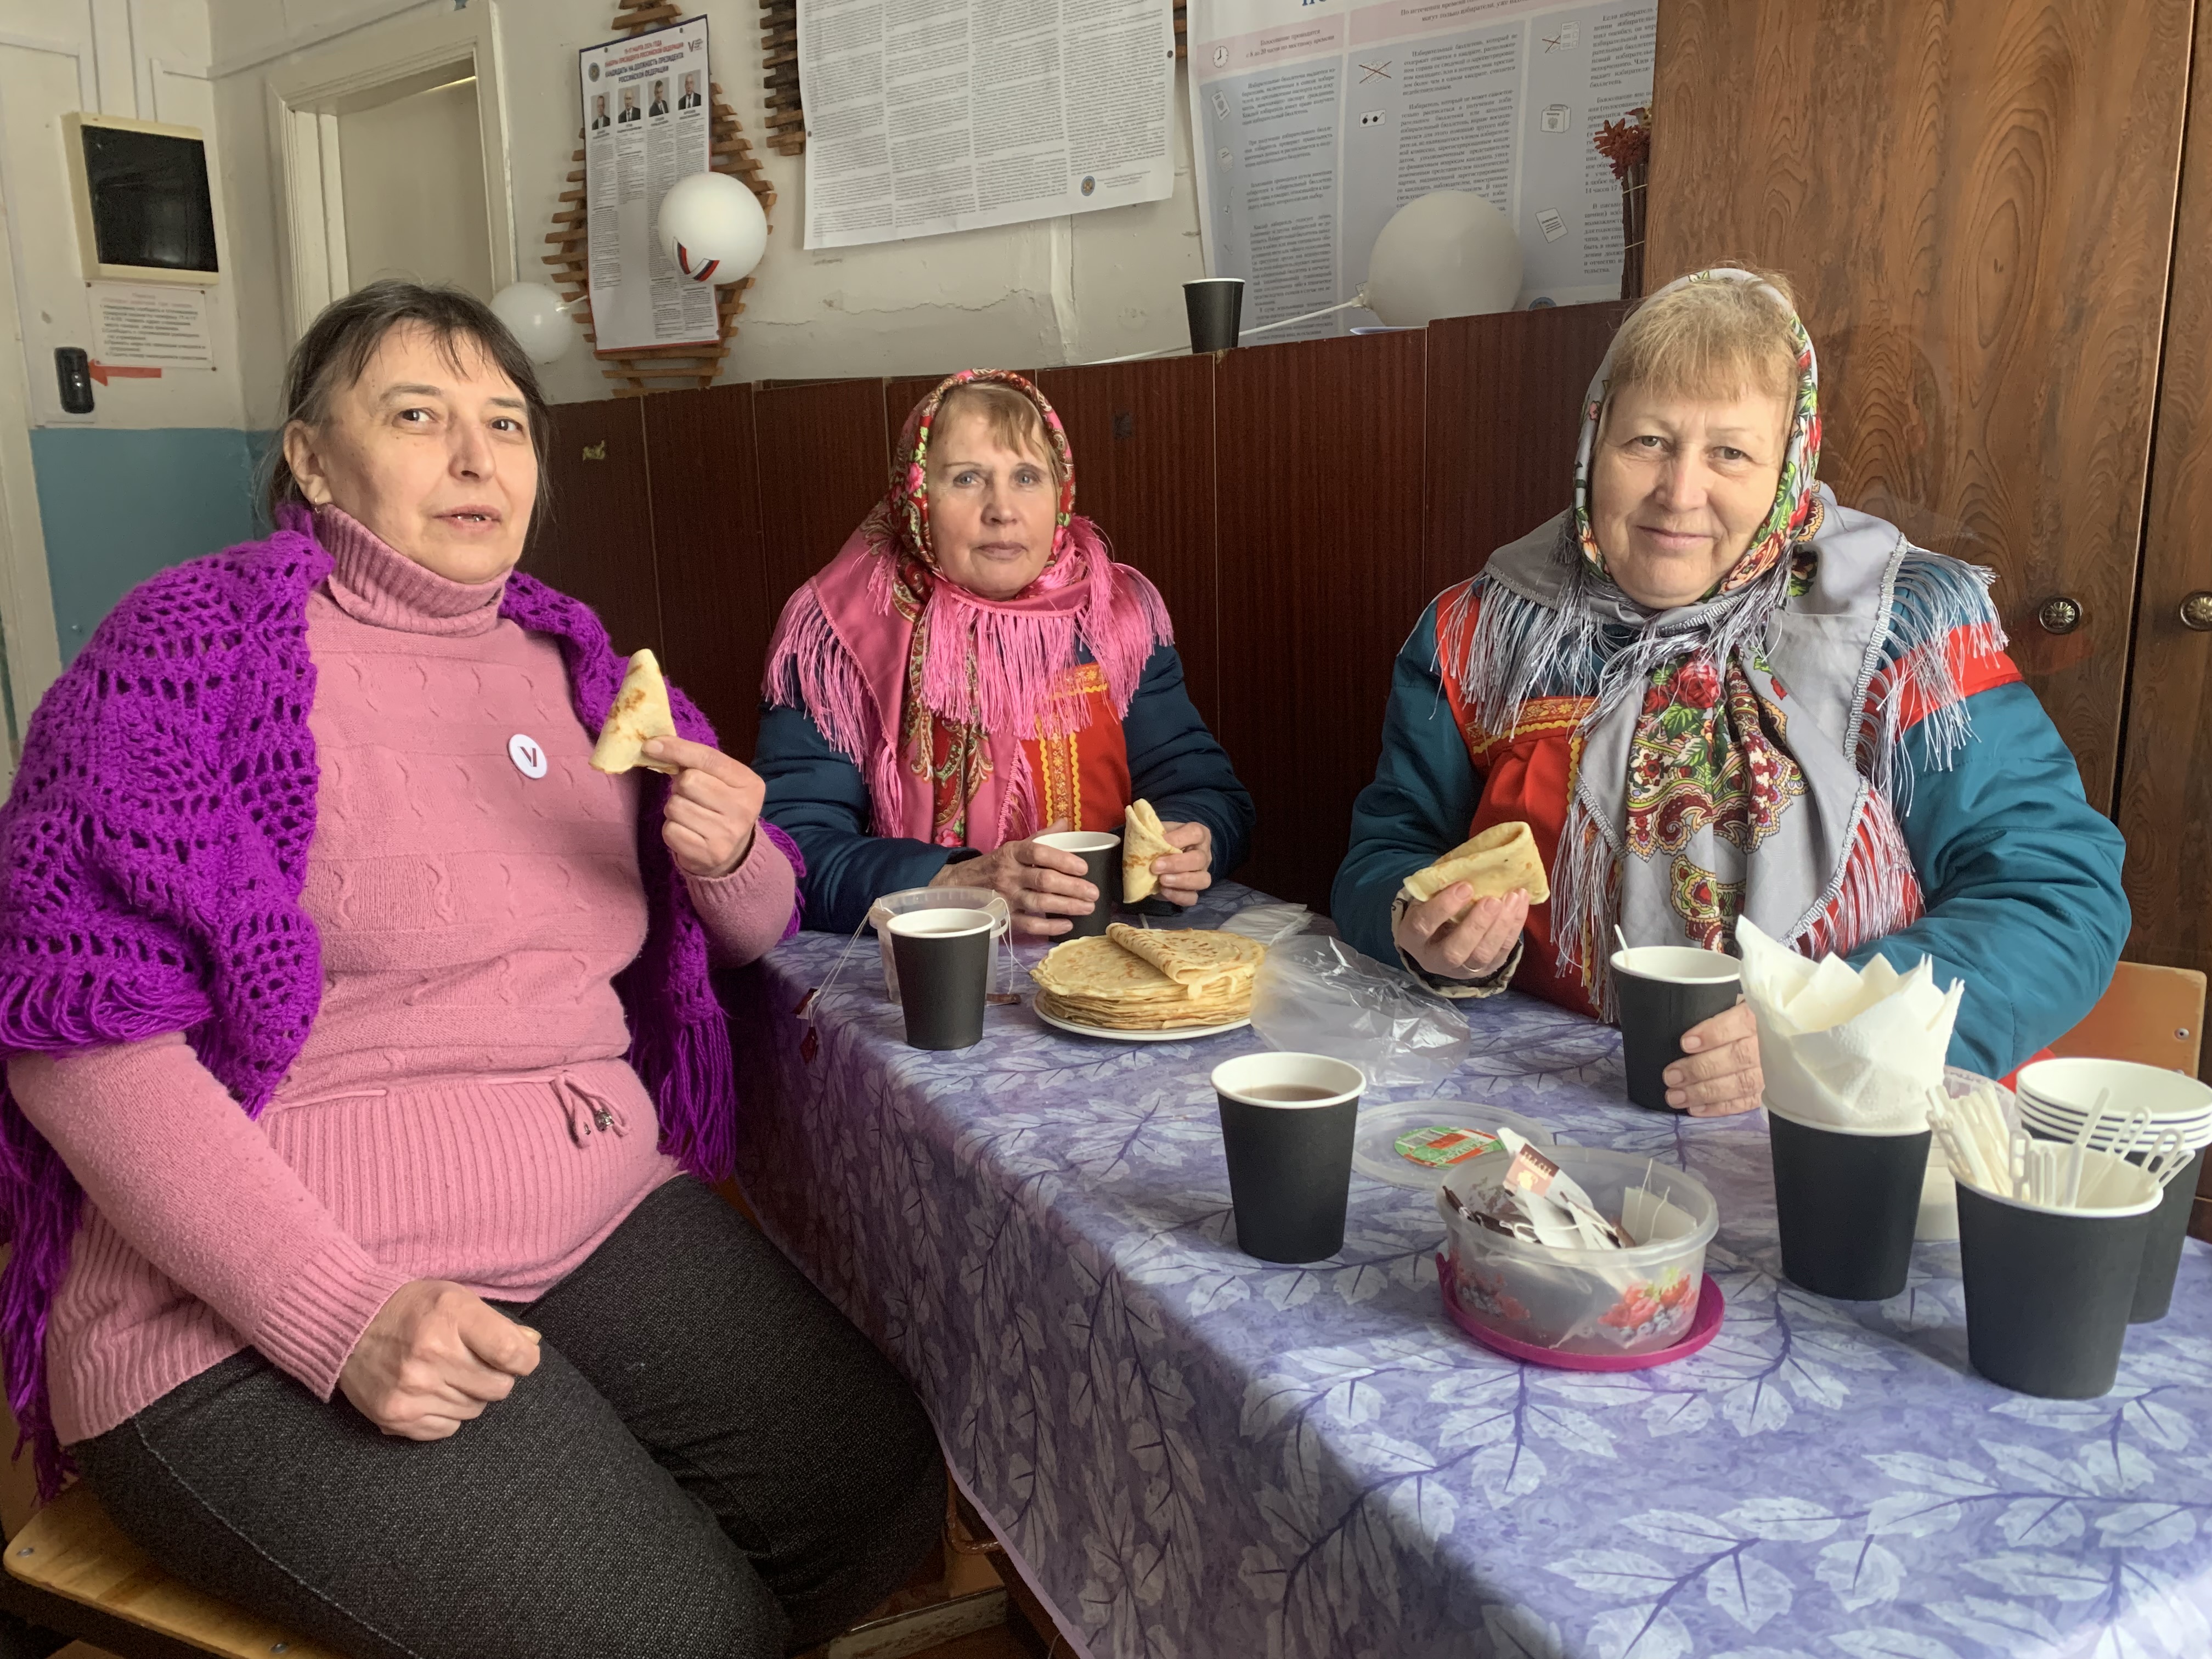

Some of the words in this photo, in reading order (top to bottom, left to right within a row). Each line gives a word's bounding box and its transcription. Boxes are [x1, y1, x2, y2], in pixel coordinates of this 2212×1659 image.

[1410, 4, 1440, 14] истечении
[1620, 9, 1652, 18] избиратель
[1593, 35, 1637, 47] избирательной
